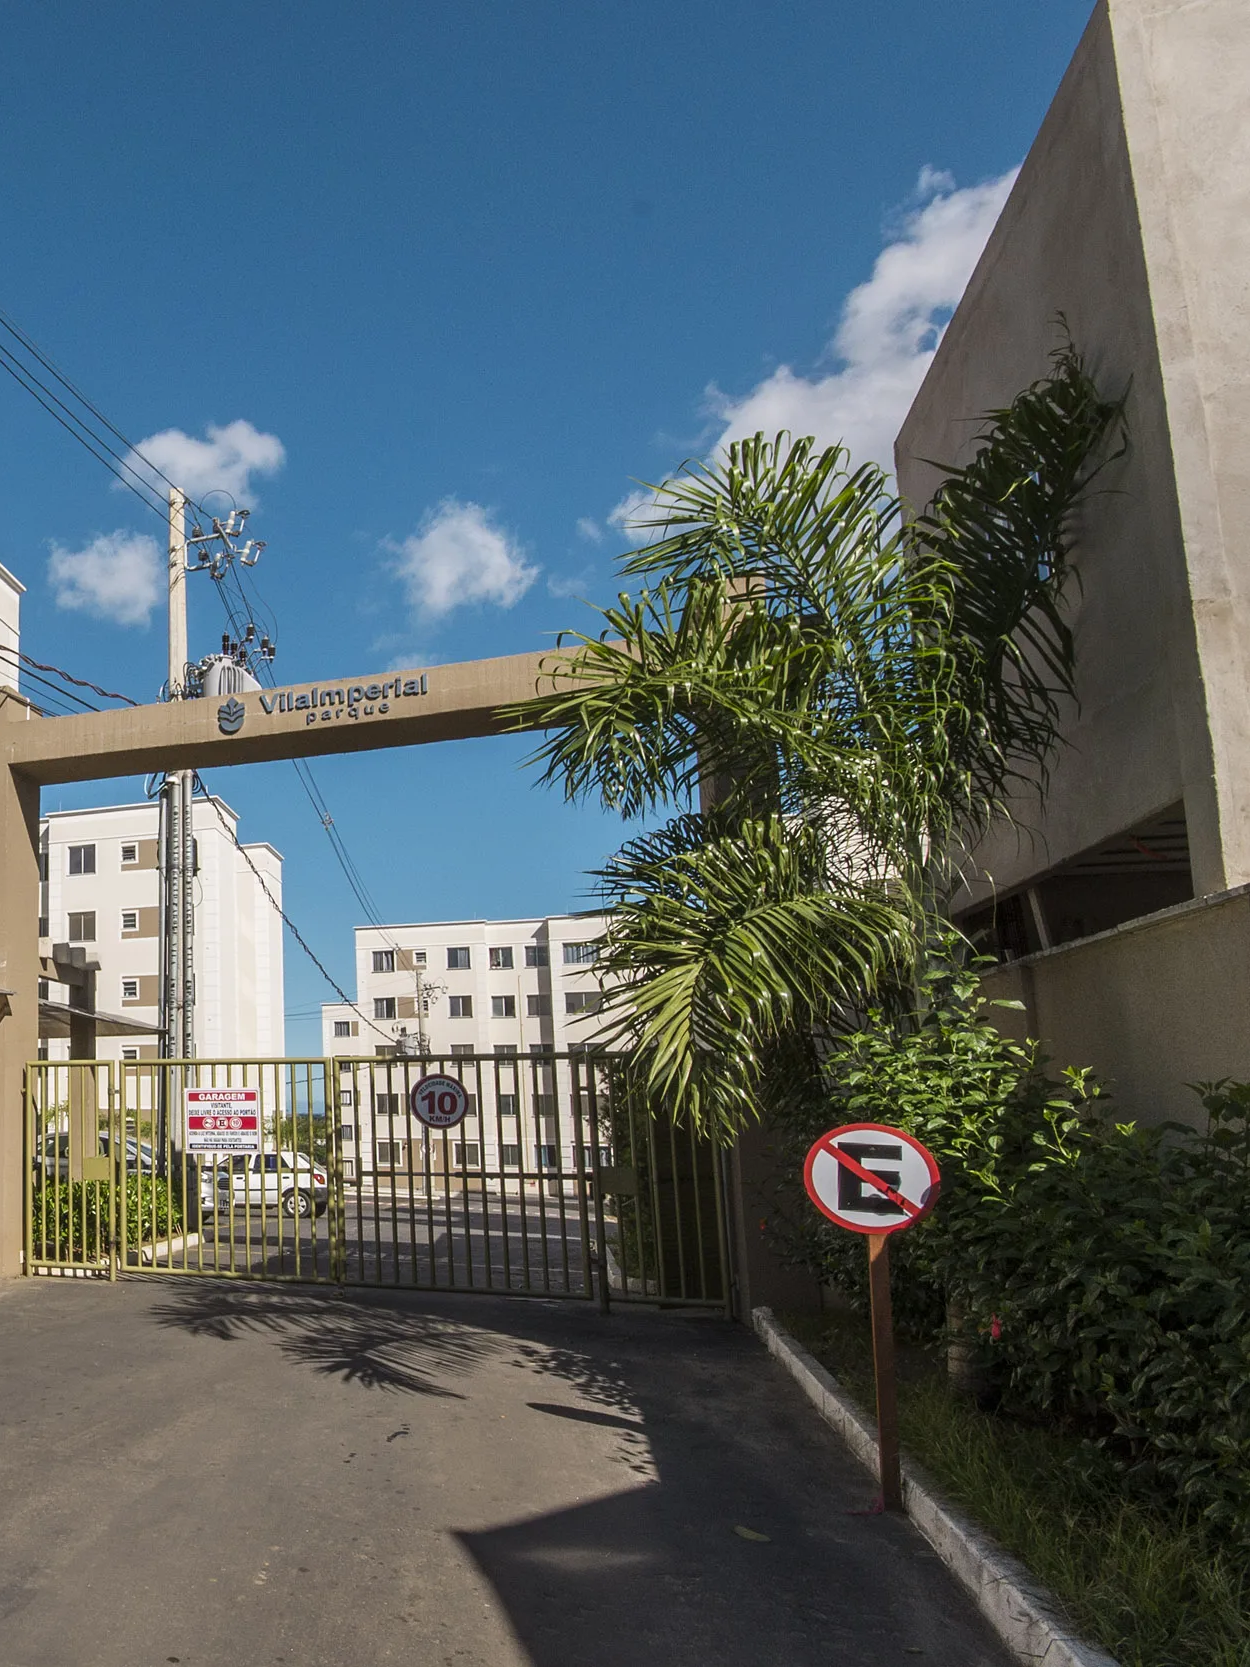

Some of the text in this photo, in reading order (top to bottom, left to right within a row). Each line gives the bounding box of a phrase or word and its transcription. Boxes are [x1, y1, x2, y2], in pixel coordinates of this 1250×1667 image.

[259, 672, 428, 714] VilaImperial
[306, 701, 391, 726] parque
[421, 1091, 458, 1115] 10
[838, 1142, 904, 1215] E
